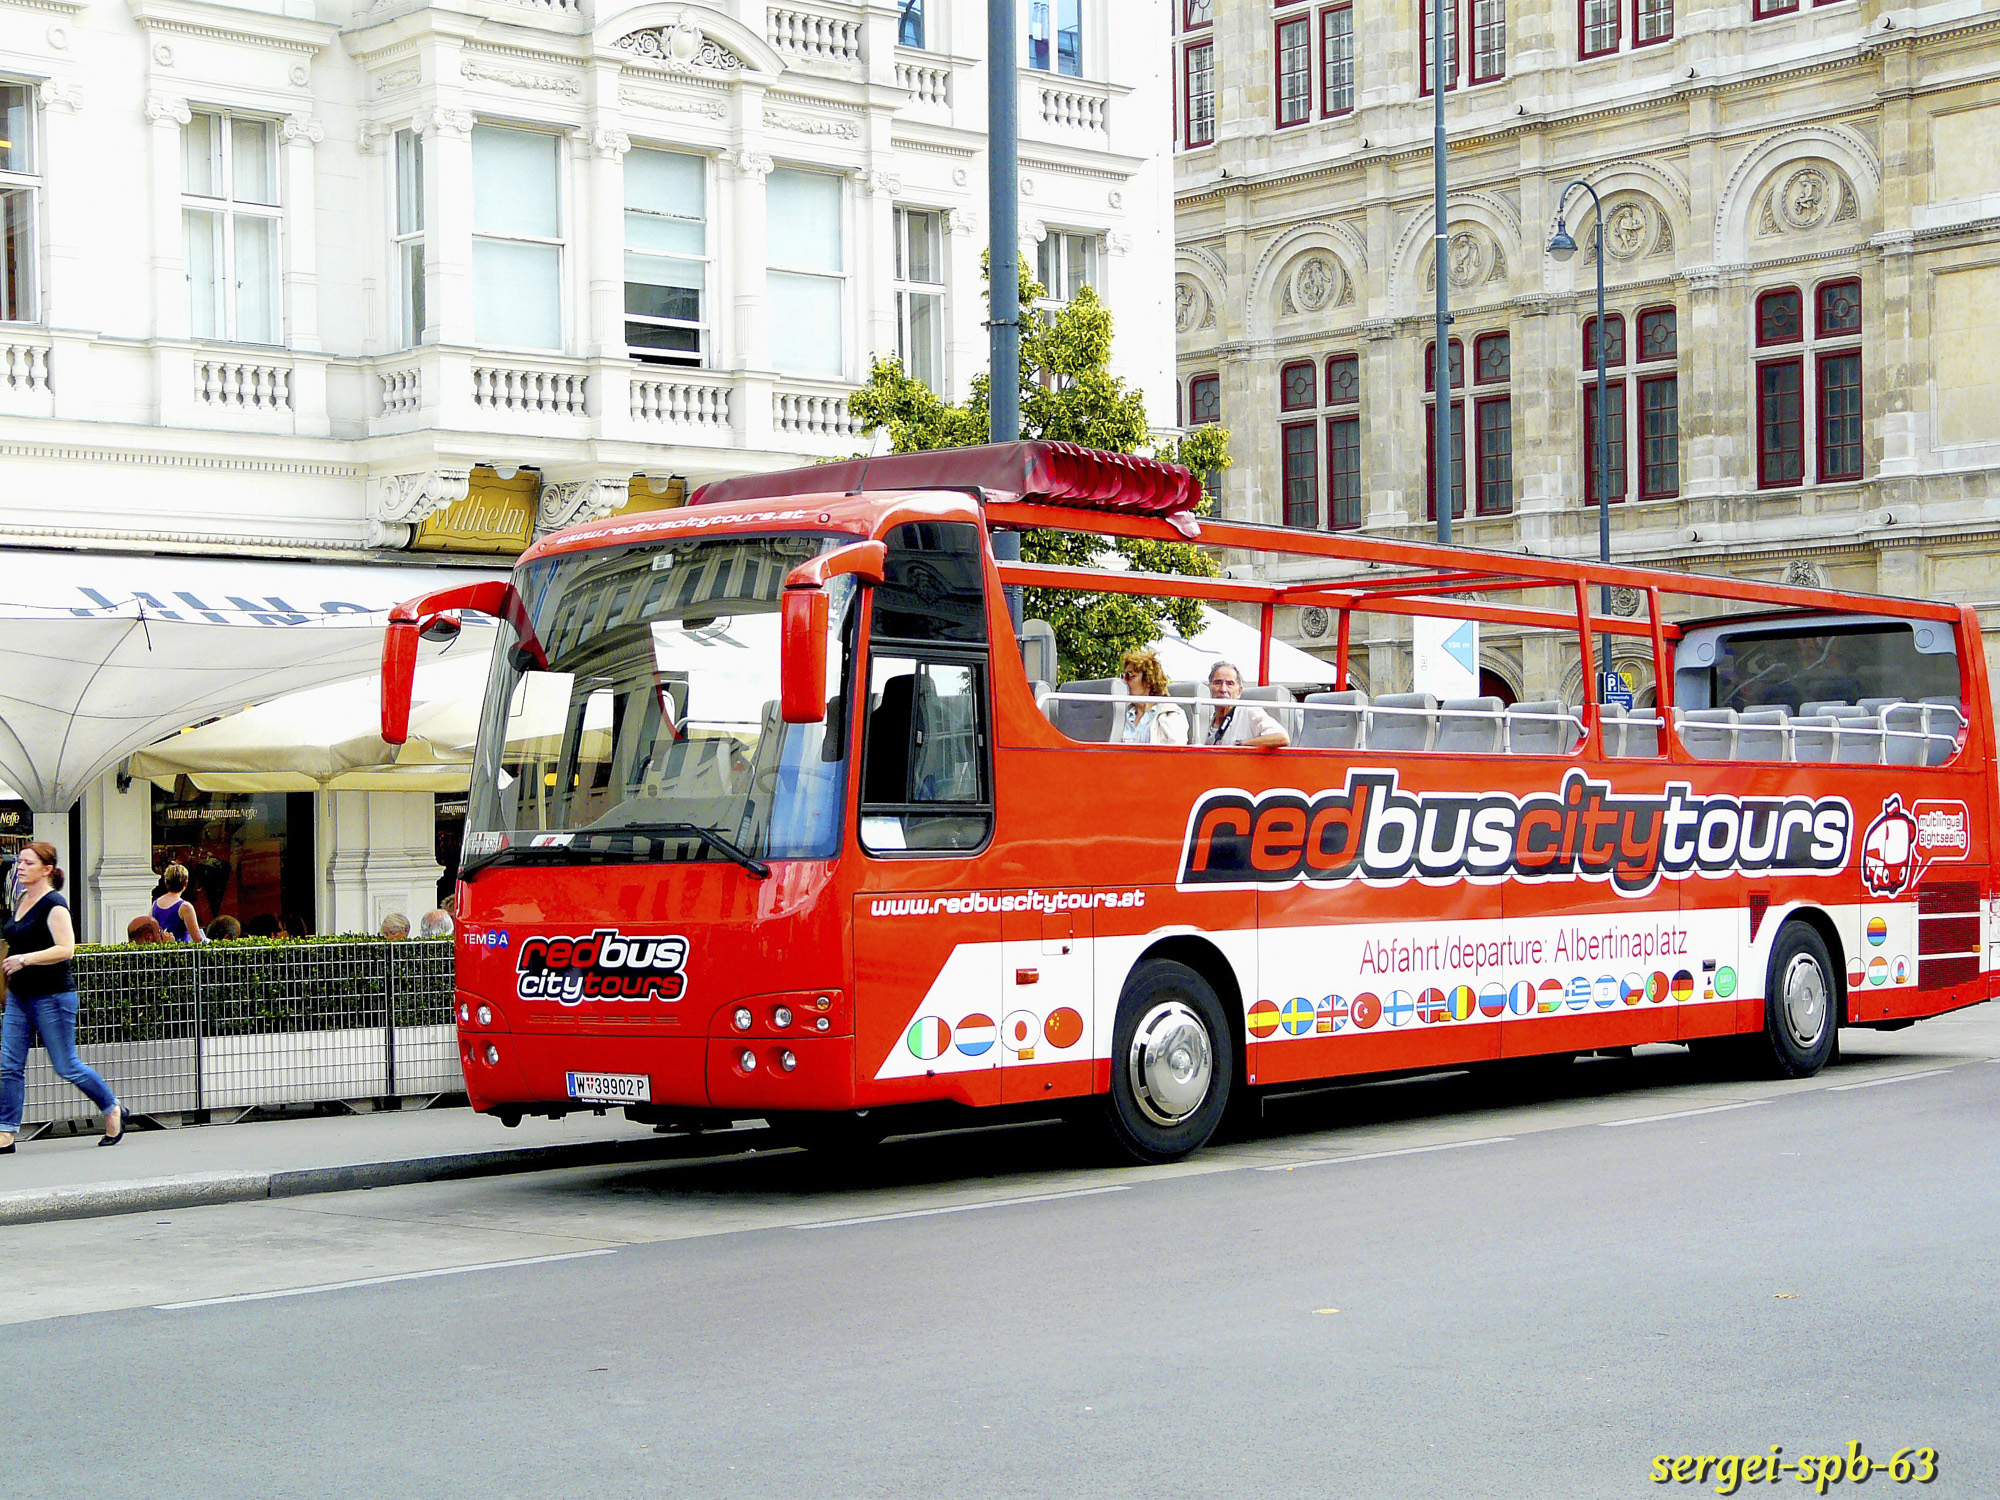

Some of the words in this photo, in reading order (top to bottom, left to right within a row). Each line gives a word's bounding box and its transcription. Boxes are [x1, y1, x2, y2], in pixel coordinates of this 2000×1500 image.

[434, 494, 525, 535] Wilhelm
[556, 509, 807, 545] www.redbuscitytours.at
[1, 811, 20, 827] Neffe
[167, 807, 198, 820] Wilhelm
[1919, 813, 1963, 829] multilingual
[1919, 830, 1965, 846] sightseeing
[871, 889, 1146, 916] www.redbuscitytours.at
[463, 932, 510, 945] TEMSA
[1359, 935, 1548, 976] Abfahrt/departure:
[1554, 923, 1688, 966] Albertinaplatz
[521, 935, 684, 969] redbus
[520, 968, 683, 1001] citytours
[576, 1077, 585, 1094] W
[595, 1077, 634, 1096] 39902
[637, 1080, 644, 1097] P
